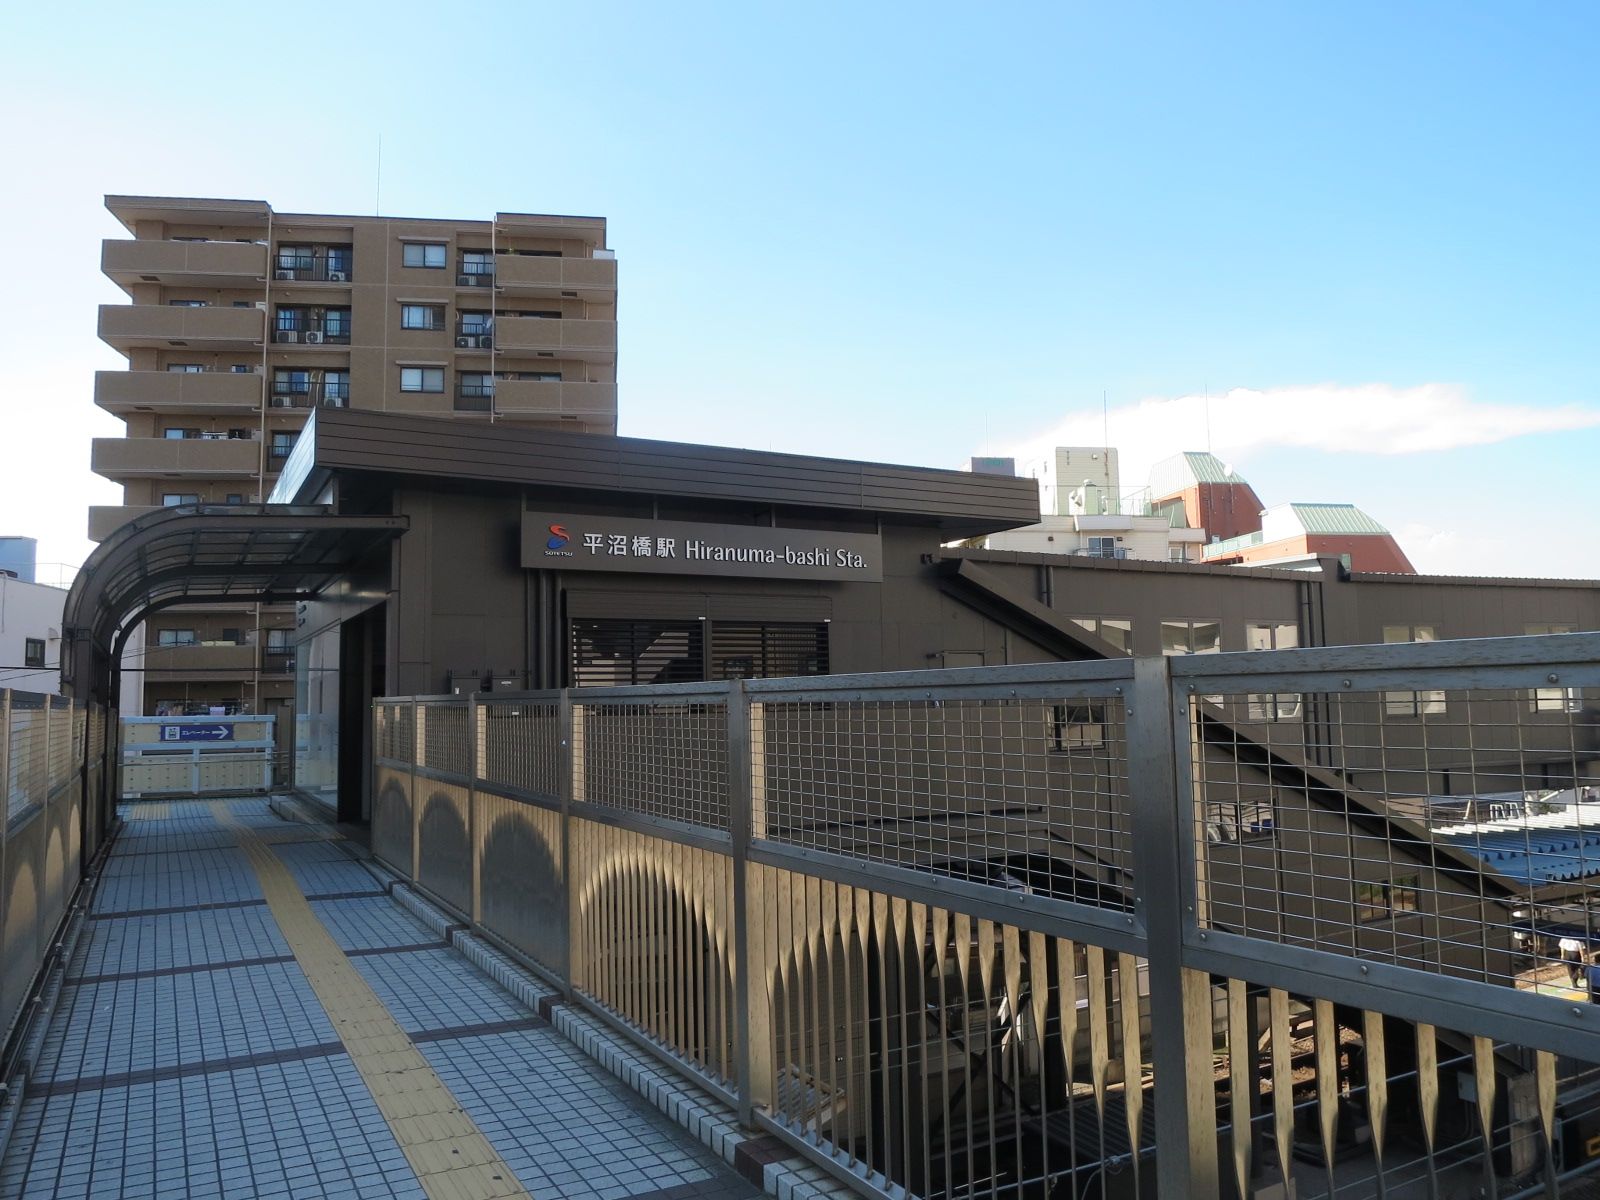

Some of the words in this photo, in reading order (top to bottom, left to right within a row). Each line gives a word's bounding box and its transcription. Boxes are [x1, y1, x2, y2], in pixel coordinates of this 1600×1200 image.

[583, 533, 676, 558] 平沼橋駅
[685, 540, 830, 567] Hiranuma-bashi
[836, 549, 868, 568] Sta.
